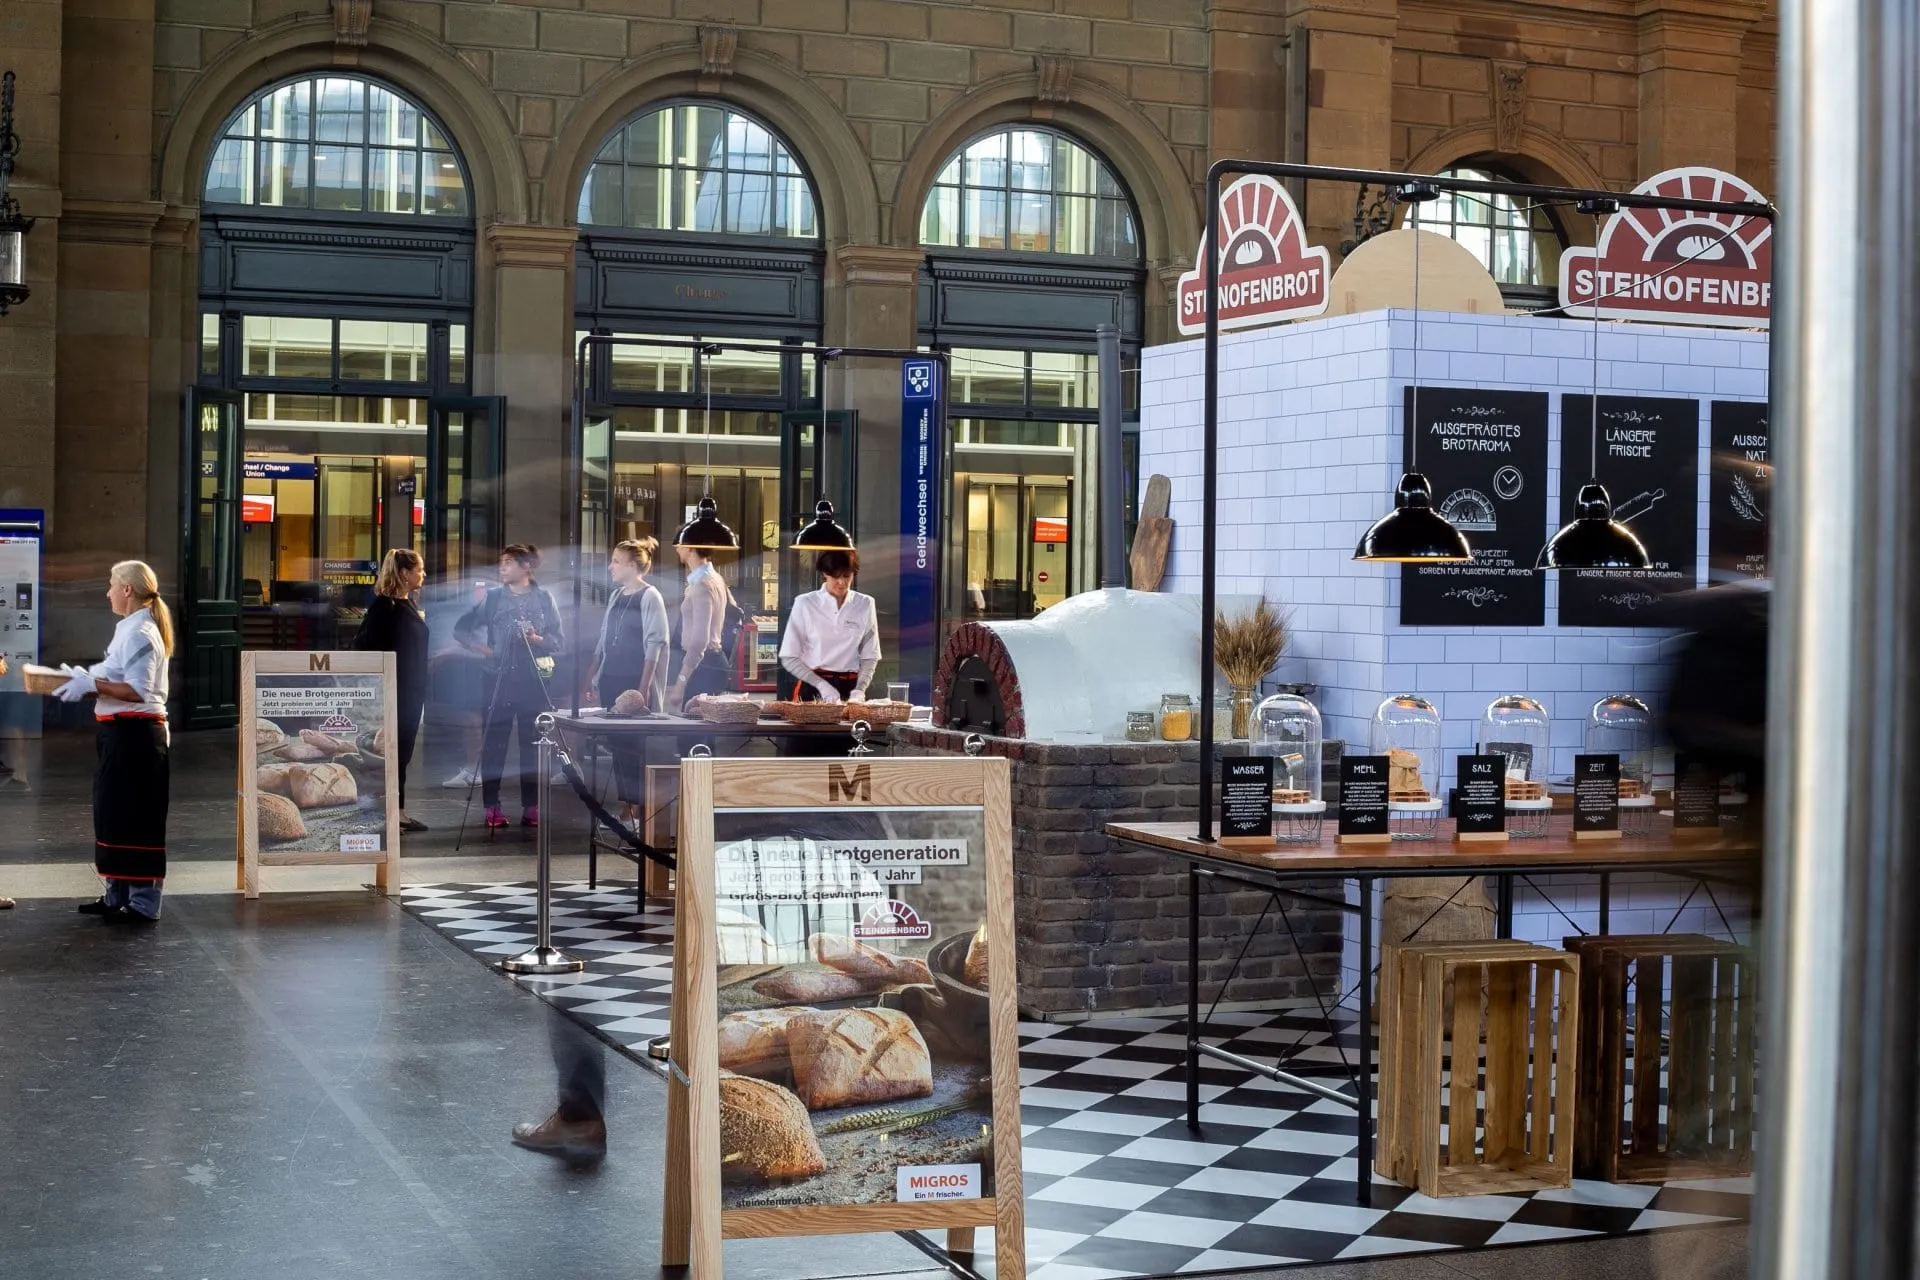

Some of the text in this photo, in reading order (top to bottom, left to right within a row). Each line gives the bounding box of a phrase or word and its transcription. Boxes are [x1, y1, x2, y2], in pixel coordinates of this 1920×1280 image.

[1184, 268, 1320, 315] STNOFENBROT
[1430, 422, 1521, 437] AUSGEPRÄGTES
[1606, 427, 1656, 443] LÄNGERE
[1442, 438, 1511, 452] BROTAROMA
[1609, 444, 1652, 457] FRISCHE
[1745, 450, 1767, 462] NAT
[264, 464, 290, 473] Change
[916, 479, 927, 569] Geldwechsel
[309, 653, 330, 671] M
[262, 690, 277, 698] Die
[305, 690, 372, 699] Brotgeneration
[301, 709, 335, 717] gewinnen!
[1232, 765, 1265, 775] WASSER
[1353, 765, 1377, 774] MEHL
[1472, 764, 1492, 773] SALZ
[1589, 763, 1605, 772] ZEIT
[828, 764, 872, 802] M
[821, 845, 960, 864] Brotgeneration
[885, 869, 916, 881] Jahr
[855, 926, 927, 935] STEINOFENBROT
[910, 1174, 969, 1188] MIGROS
[936, 1190, 965, 1198] frischer.
[736, 1197, 817, 1209] steinofenbrot.ch
